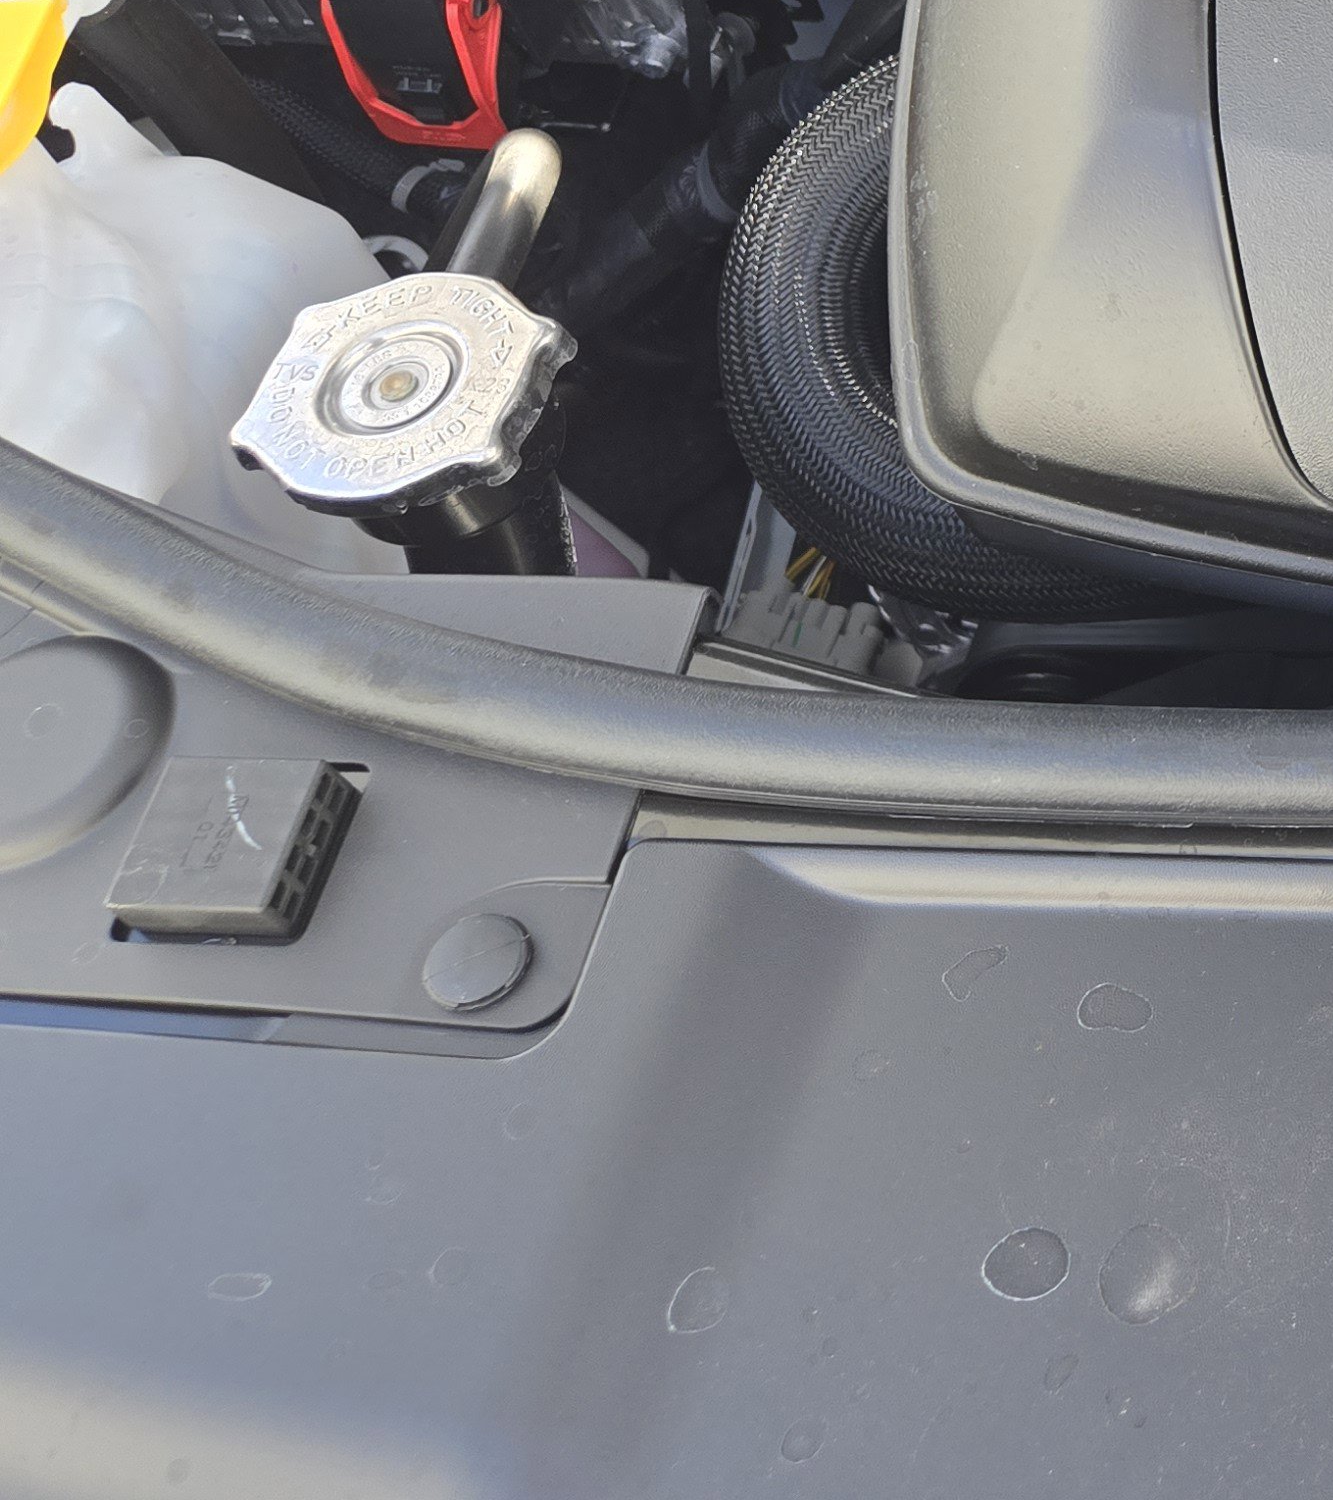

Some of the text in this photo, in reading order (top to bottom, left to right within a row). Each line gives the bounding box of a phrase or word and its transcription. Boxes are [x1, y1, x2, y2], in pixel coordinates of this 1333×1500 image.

[336, 283, 515, 343] KEEP TIGHT
[273, 361, 321, 383] TVS
[269, 422, 327, 470] NOT
[323, 444, 418, 479] OPEN
[422, 400, 485, 455] HOT
